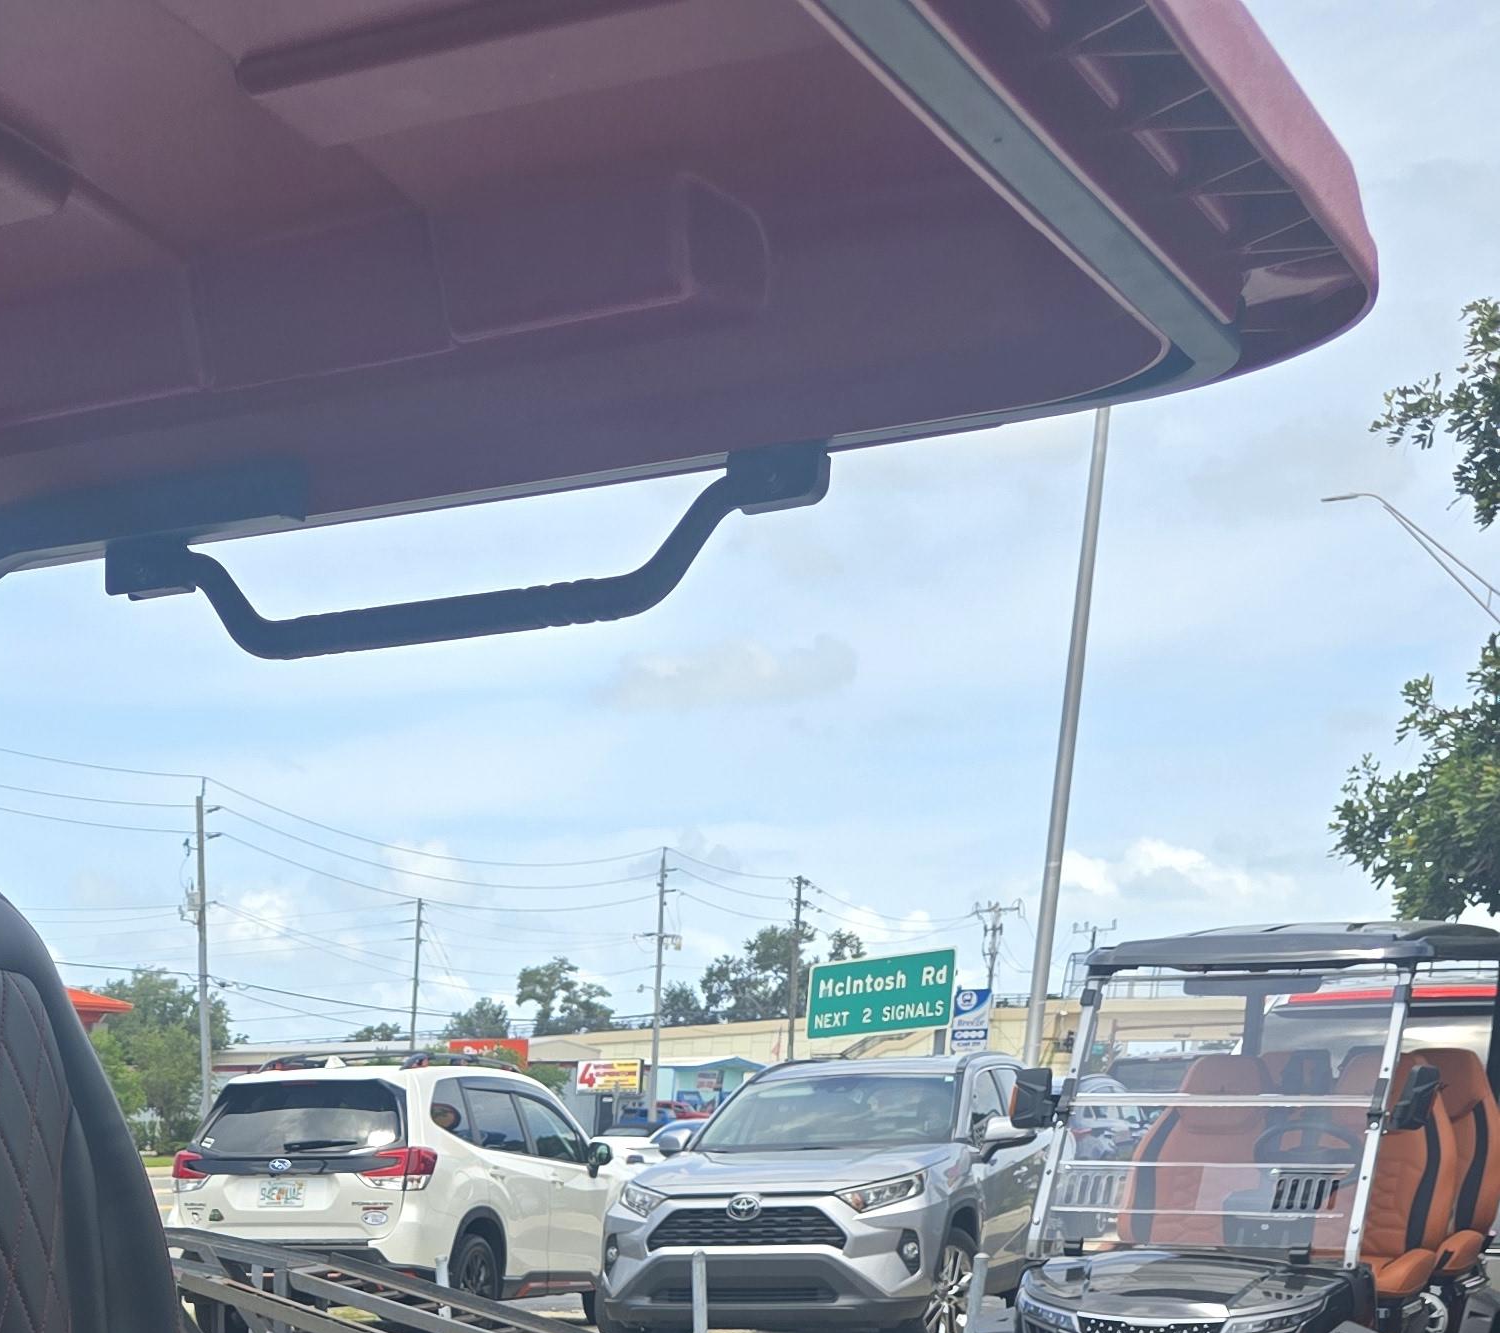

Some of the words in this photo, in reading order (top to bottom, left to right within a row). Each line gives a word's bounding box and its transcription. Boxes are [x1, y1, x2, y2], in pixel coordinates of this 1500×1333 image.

[818, 969, 907, 999] McIntosh
[921, 964, 947, 987] Rd
[814, 1010, 850, 1030] NEXT
[861, 1007, 872, 1024] 2
[881, 1000, 945, 1022] SIGNALS
[578, 1062, 596, 1088] 4
